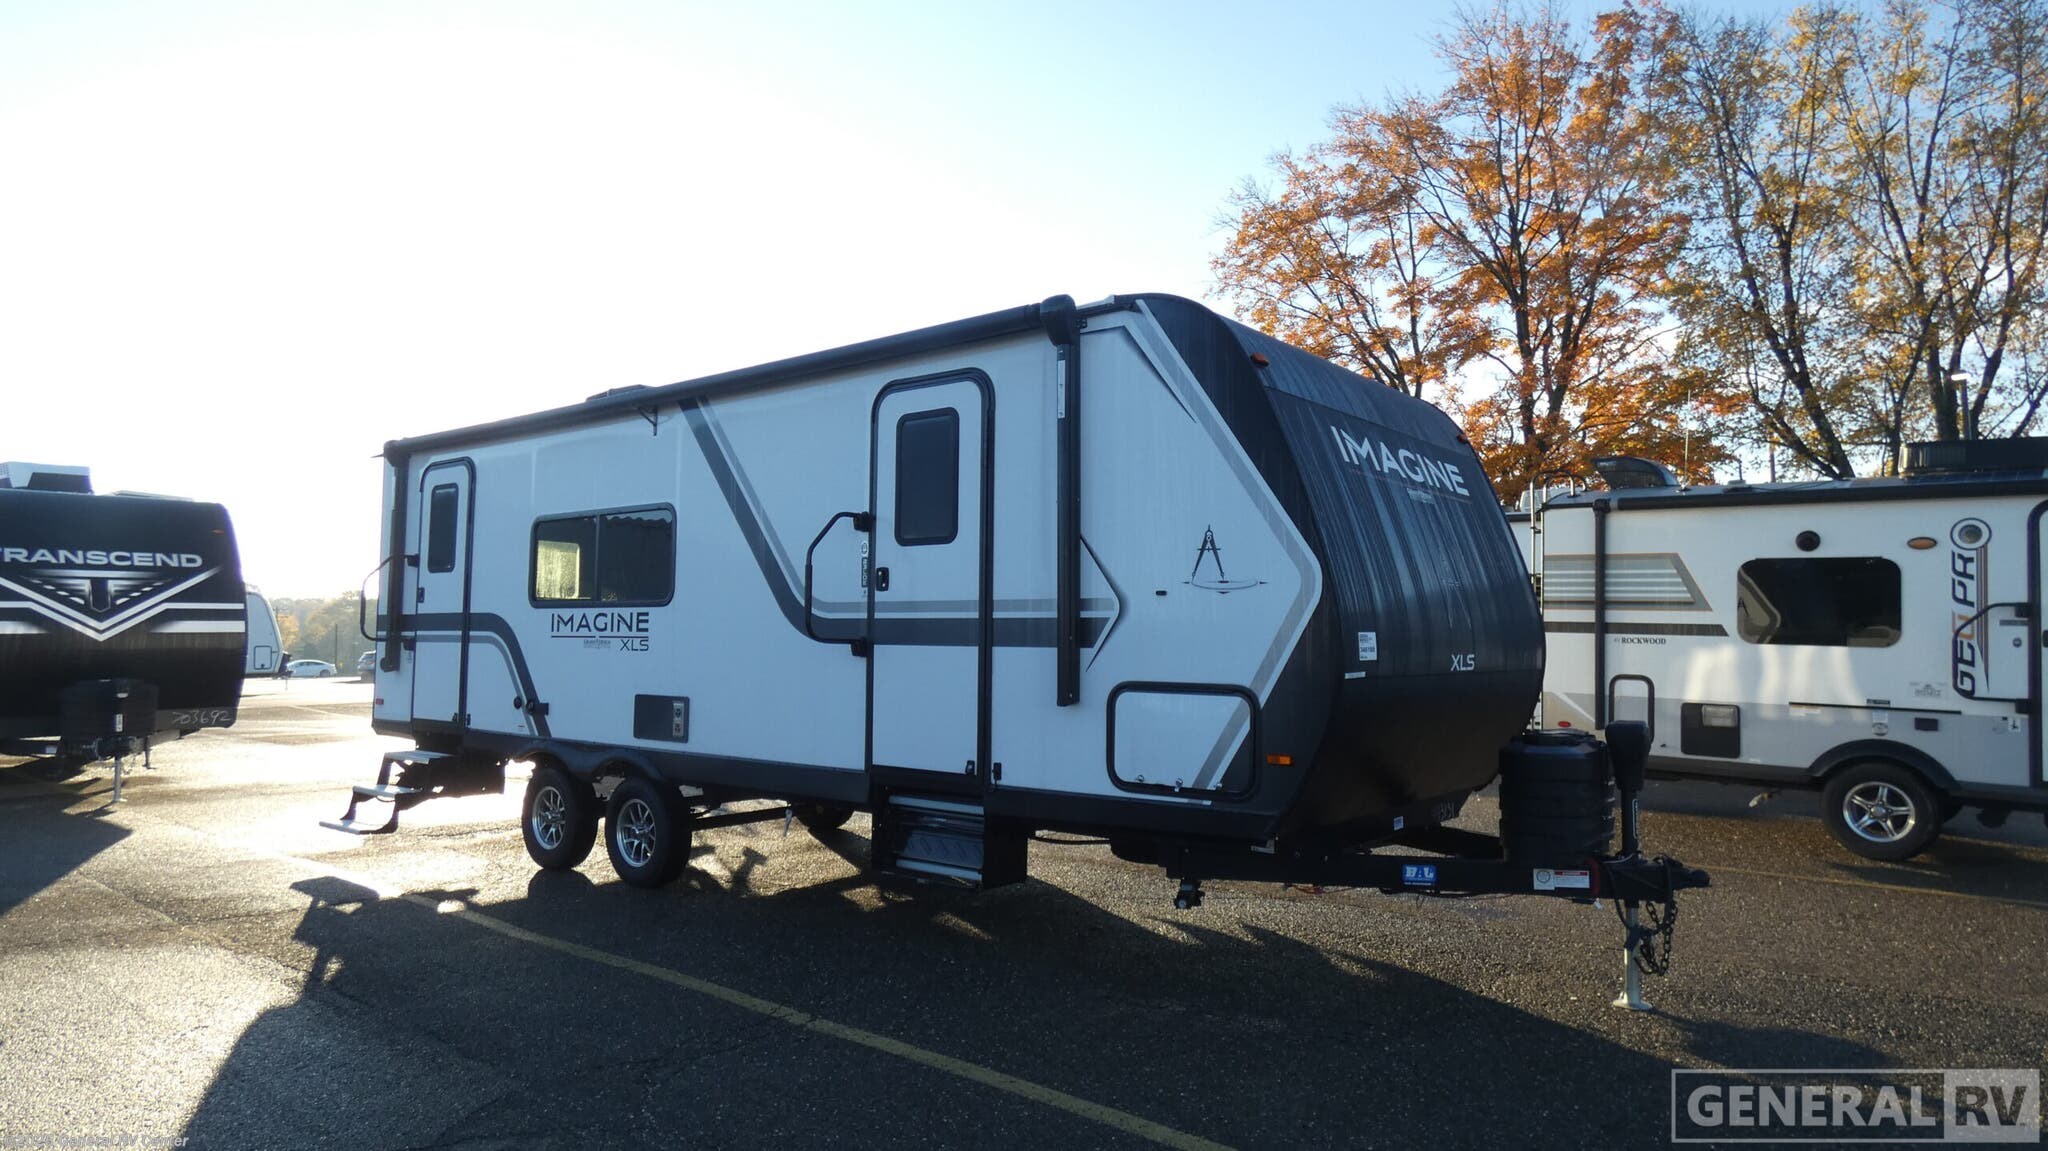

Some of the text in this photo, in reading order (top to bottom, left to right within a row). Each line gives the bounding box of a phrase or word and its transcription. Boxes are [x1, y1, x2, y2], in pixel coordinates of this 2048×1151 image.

[1330, 425, 1470, 496] IMAGINE
[0, 547, 203, 568] RANSCEND
[551, 612, 649, 632] IMAGINE
[619, 639, 649, 652] XLS
[1621, 637, 1666, 645] ROCKWOOD
[1450, 654, 1475, 671] XLS
